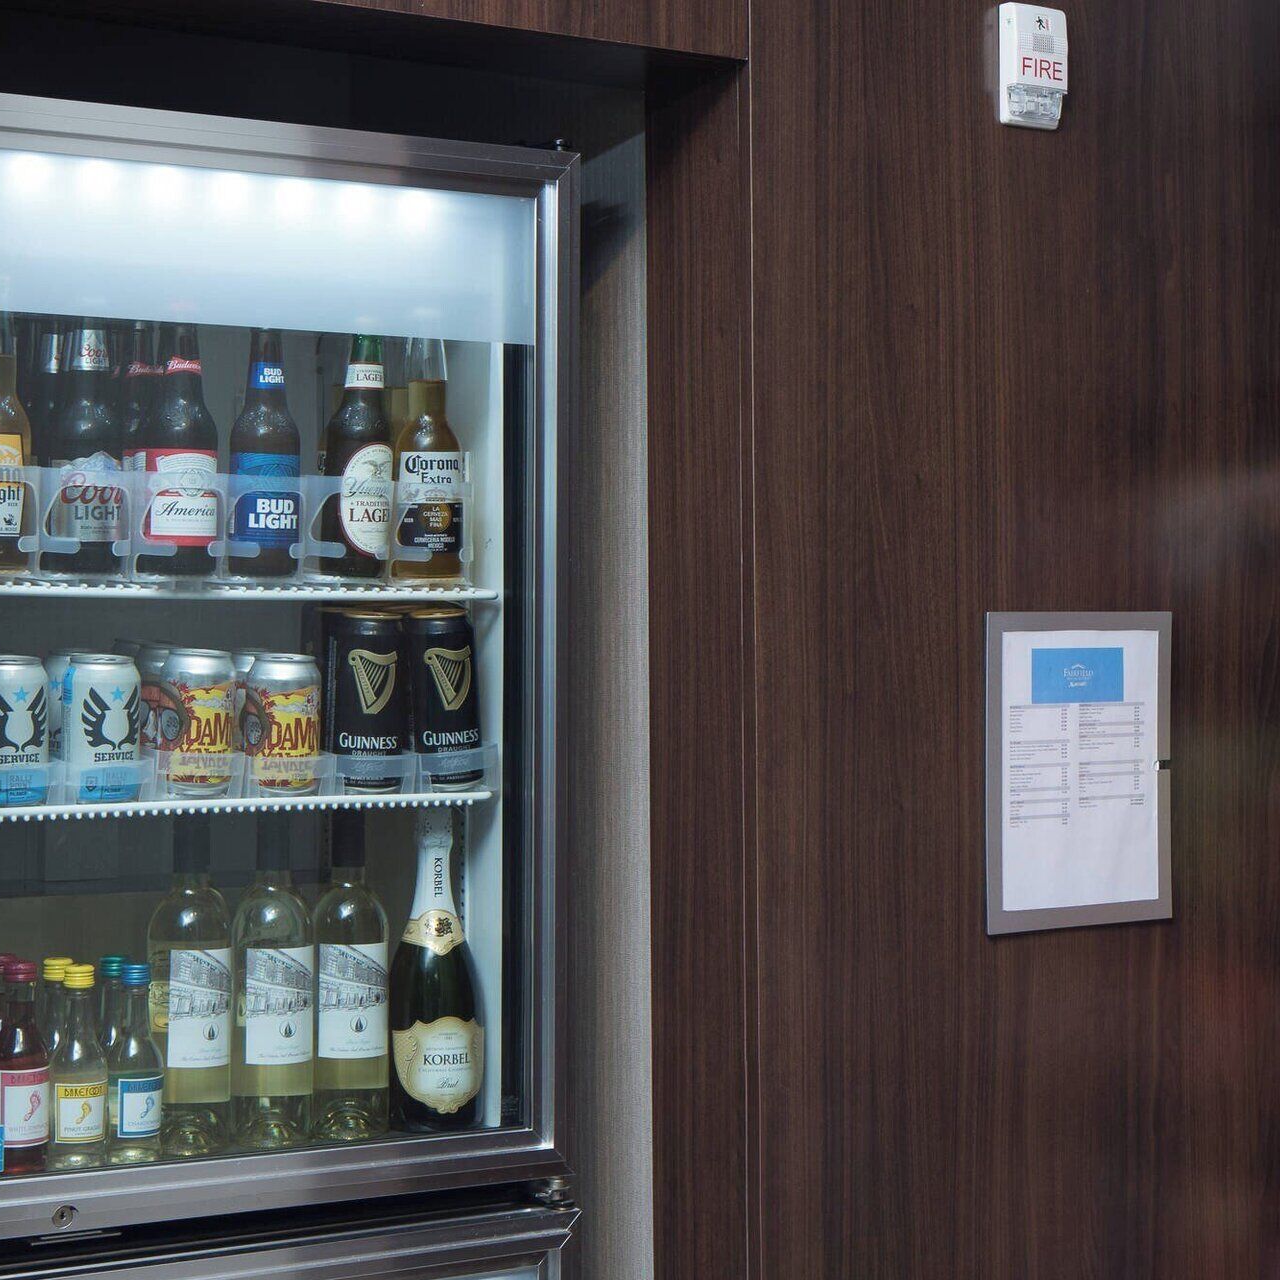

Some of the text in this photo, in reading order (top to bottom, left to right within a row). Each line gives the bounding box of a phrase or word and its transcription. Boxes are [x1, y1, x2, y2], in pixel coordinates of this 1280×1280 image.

[1022, 57, 1063, 81] FIRE
[259, 375, 285, 384] LIGHT
[263, 367, 283, 376] BUD
[404, 455, 460, 476] Corona
[421, 472, 452, 484] Extra
[155, 502, 215, 518] America
[256, 498, 295, 514] BUD
[248, 514, 298, 530] LIGHT
[339, 732, 397, 750] GUINNESS
[422, 729, 479, 747] GUINNESS
[94, 751, 134, 763] SERVICE
[433, 857, 443, 898] KORBEL
[423, 1053, 470, 1065] KORBEL
